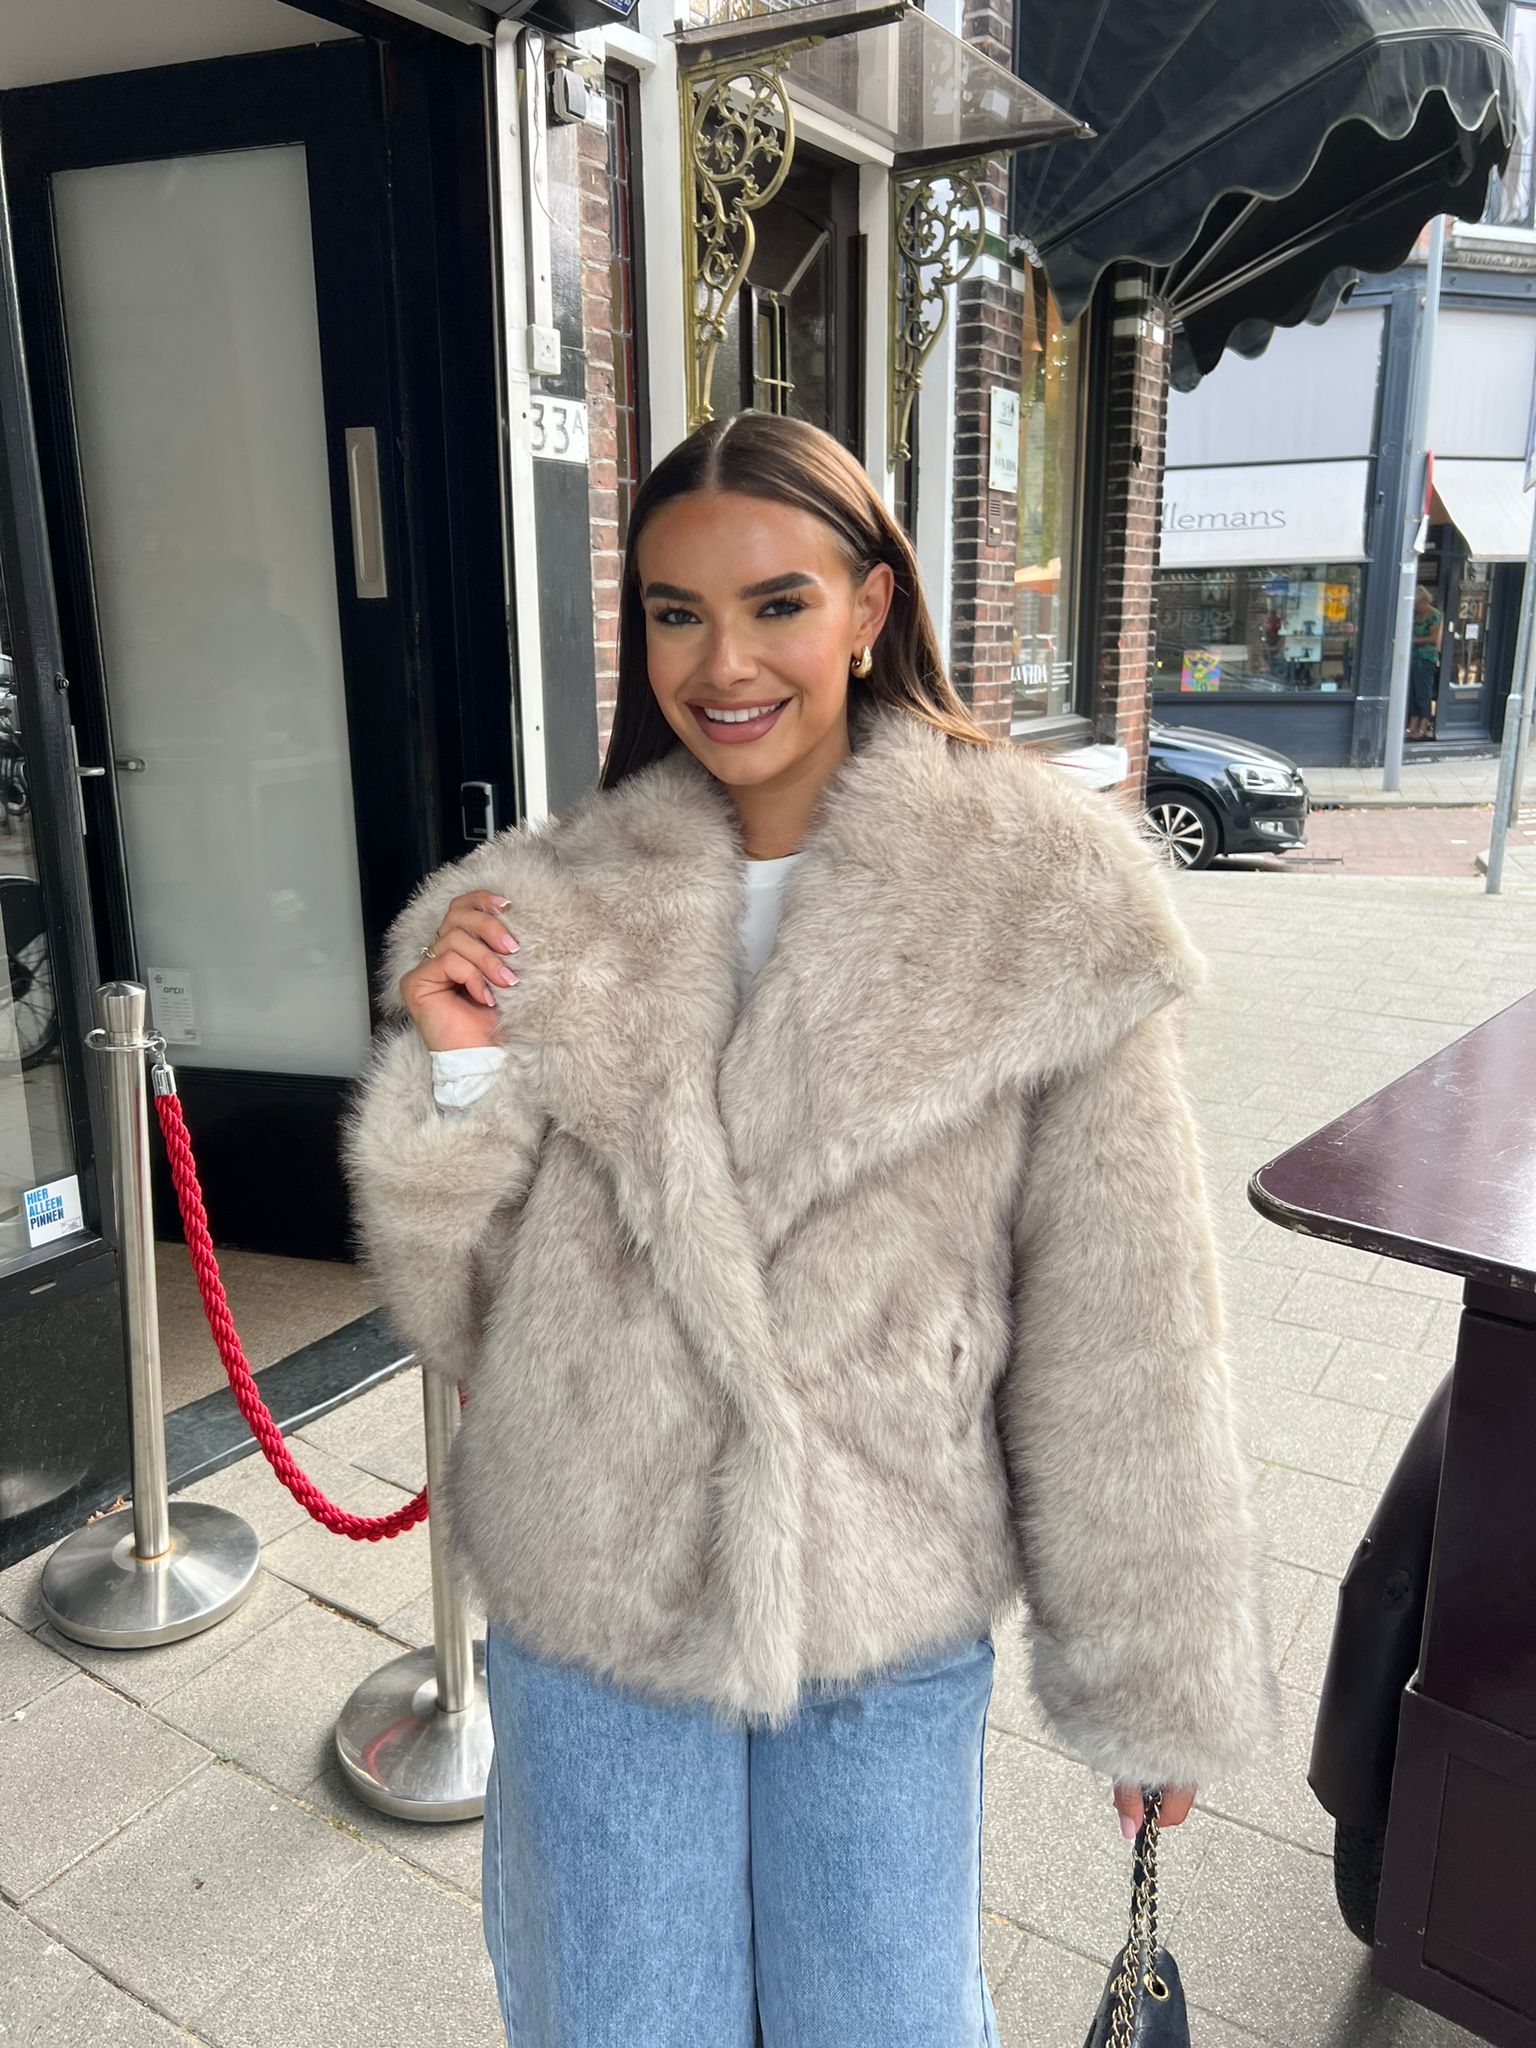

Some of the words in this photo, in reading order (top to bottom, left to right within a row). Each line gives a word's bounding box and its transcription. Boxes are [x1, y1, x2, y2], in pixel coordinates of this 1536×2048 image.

[1022, 664, 1048, 685] VIDA
[27, 1188, 48, 1205] HIER
[29, 1195, 63, 1217] ALLEEN
[30, 1207, 64, 1230] PINNEN
